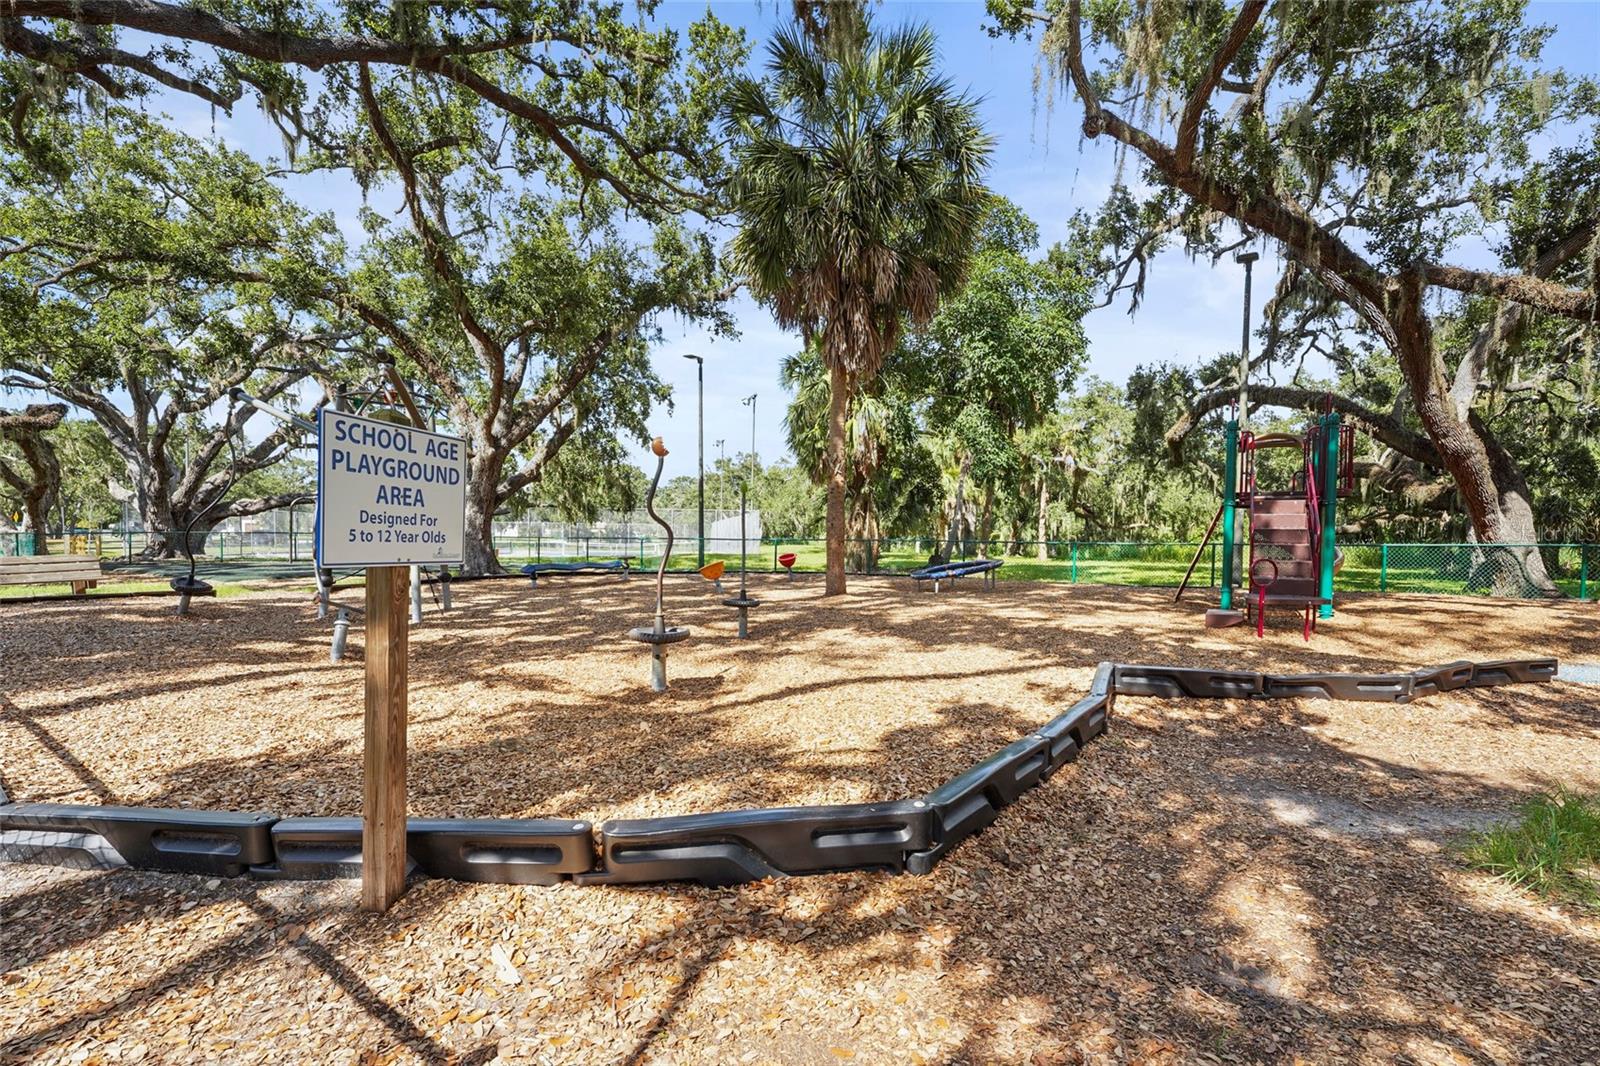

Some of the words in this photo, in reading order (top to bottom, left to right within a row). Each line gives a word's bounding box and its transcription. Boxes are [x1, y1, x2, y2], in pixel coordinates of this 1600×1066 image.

[335, 420, 417, 454] SCHOOL
[425, 438, 458, 461] AGE
[332, 449, 460, 485] PLAYGROUND
[376, 484, 425, 507] AREA
[359, 510, 417, 528] Designed
[420, 514, 438, 526] For
[348, 529, 357, 542] 5
[360, 530, 374, 542] to
[377, 530, 392, 543] 12
[394, 530, 419, 543] Year
[421, 530, 446, 544] Olds
